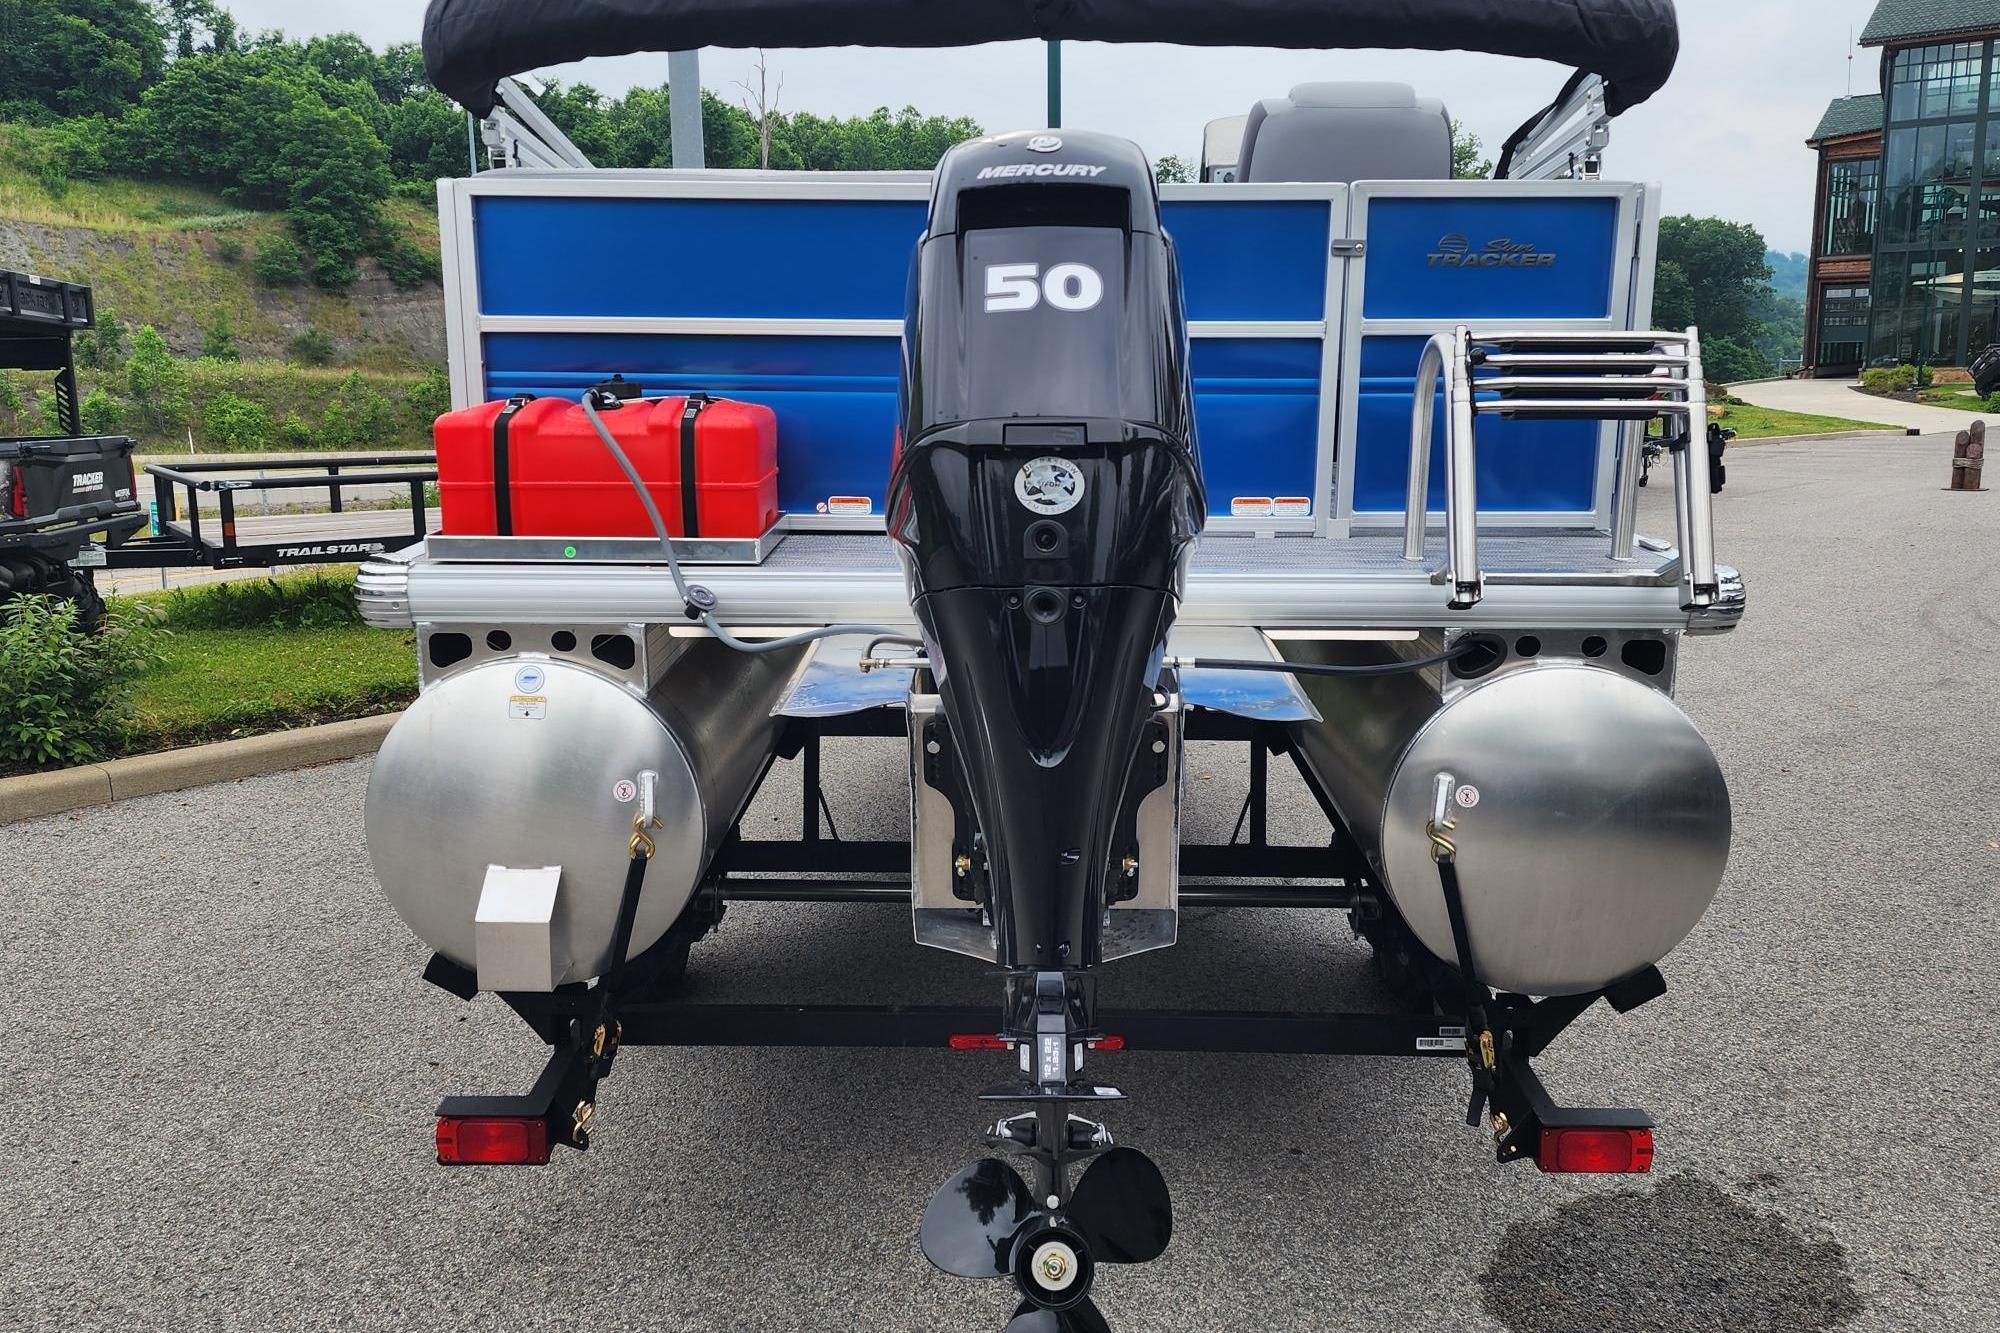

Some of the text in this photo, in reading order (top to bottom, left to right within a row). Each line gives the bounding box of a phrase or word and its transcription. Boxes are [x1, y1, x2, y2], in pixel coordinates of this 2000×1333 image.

[977, 164, 1106, 179] MERCURY
[1482, 238, 1536, 252] Sun
[1427, 253, 1556, 268] TRACKER
[984, 262, 1104, 313] 50
[72, 471, 104, 487] TRACKER
[276, 543, 370, 557] TRAILSTAR
[1044, 1037, 1052, 1054] 22
[1044, 1063, 1052, 1079] 12
